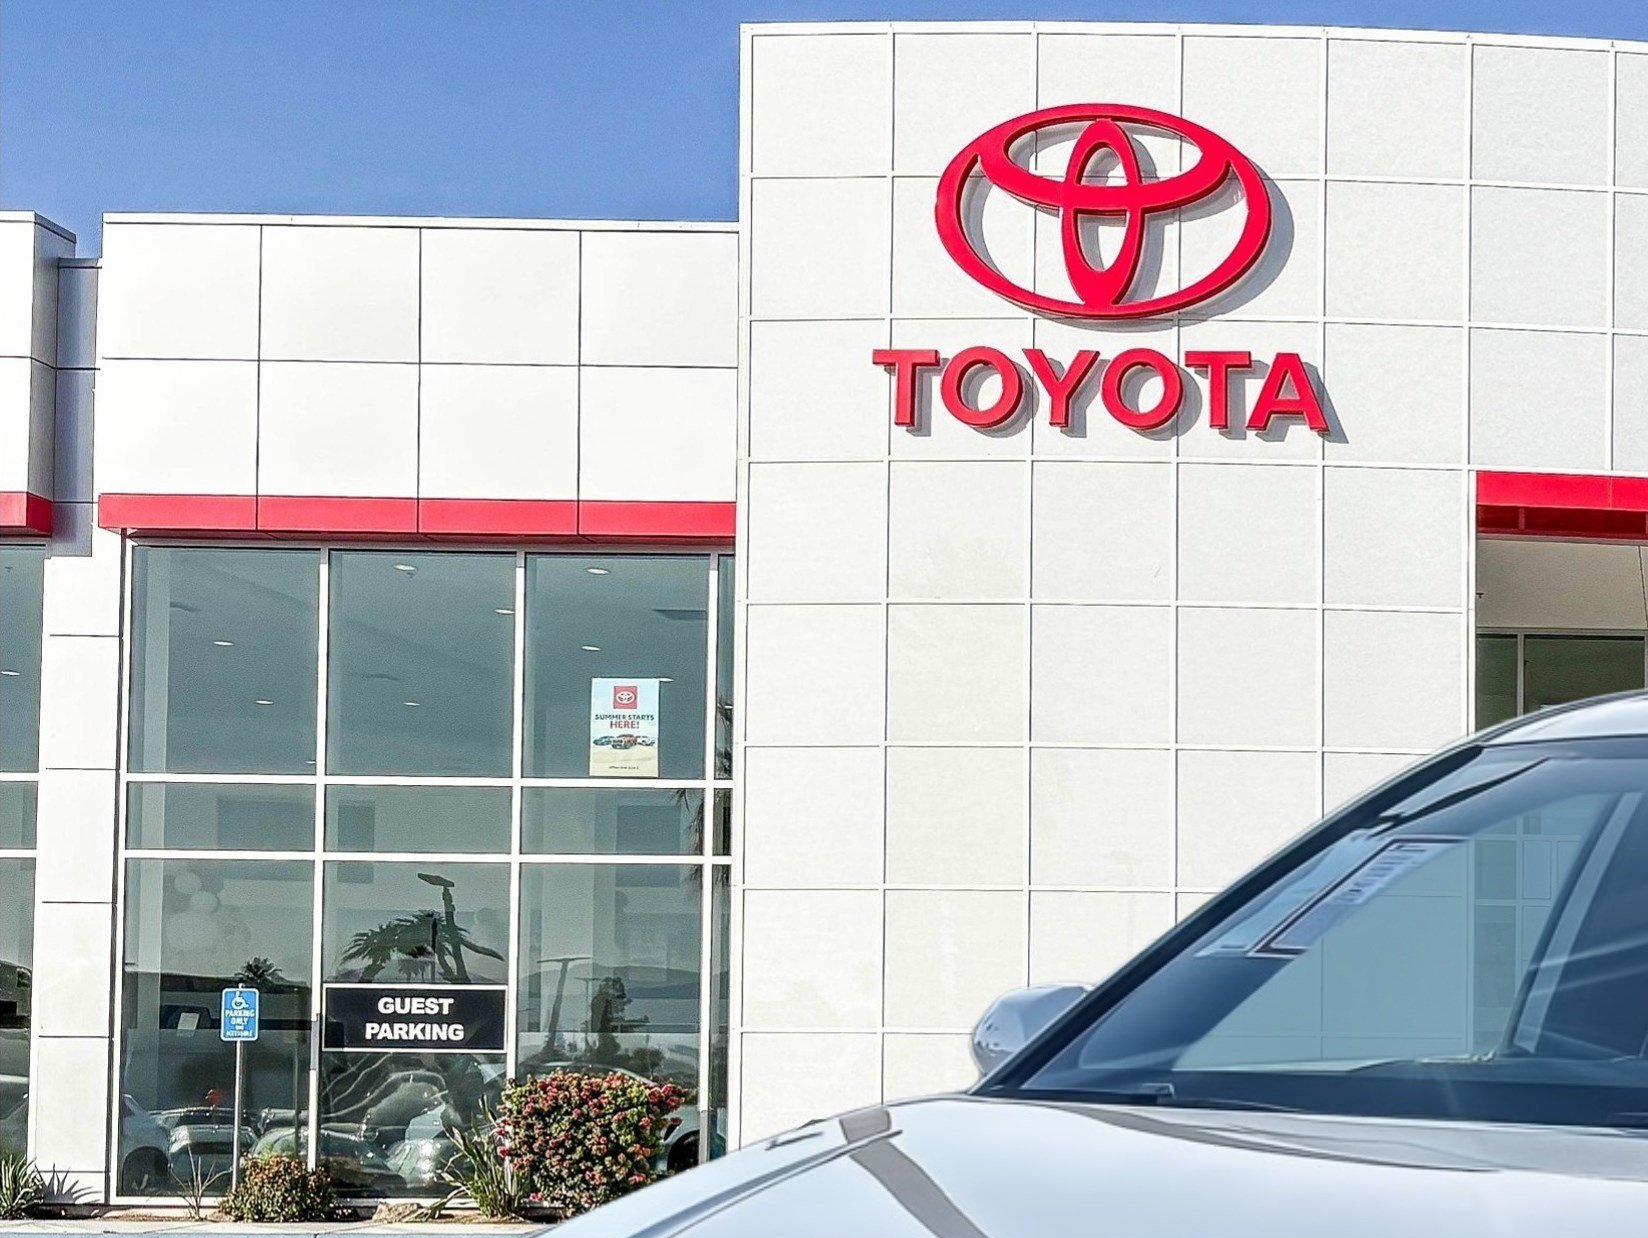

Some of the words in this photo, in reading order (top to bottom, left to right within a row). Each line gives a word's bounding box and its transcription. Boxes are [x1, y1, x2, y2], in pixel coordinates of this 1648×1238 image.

[872, 346, 1331, 434] TOYOTA
[610, 721, 640, 729] HERE!
[378, 997, 454, 1015] GUEST
[365, 1022, 464, 1041] PARKING
